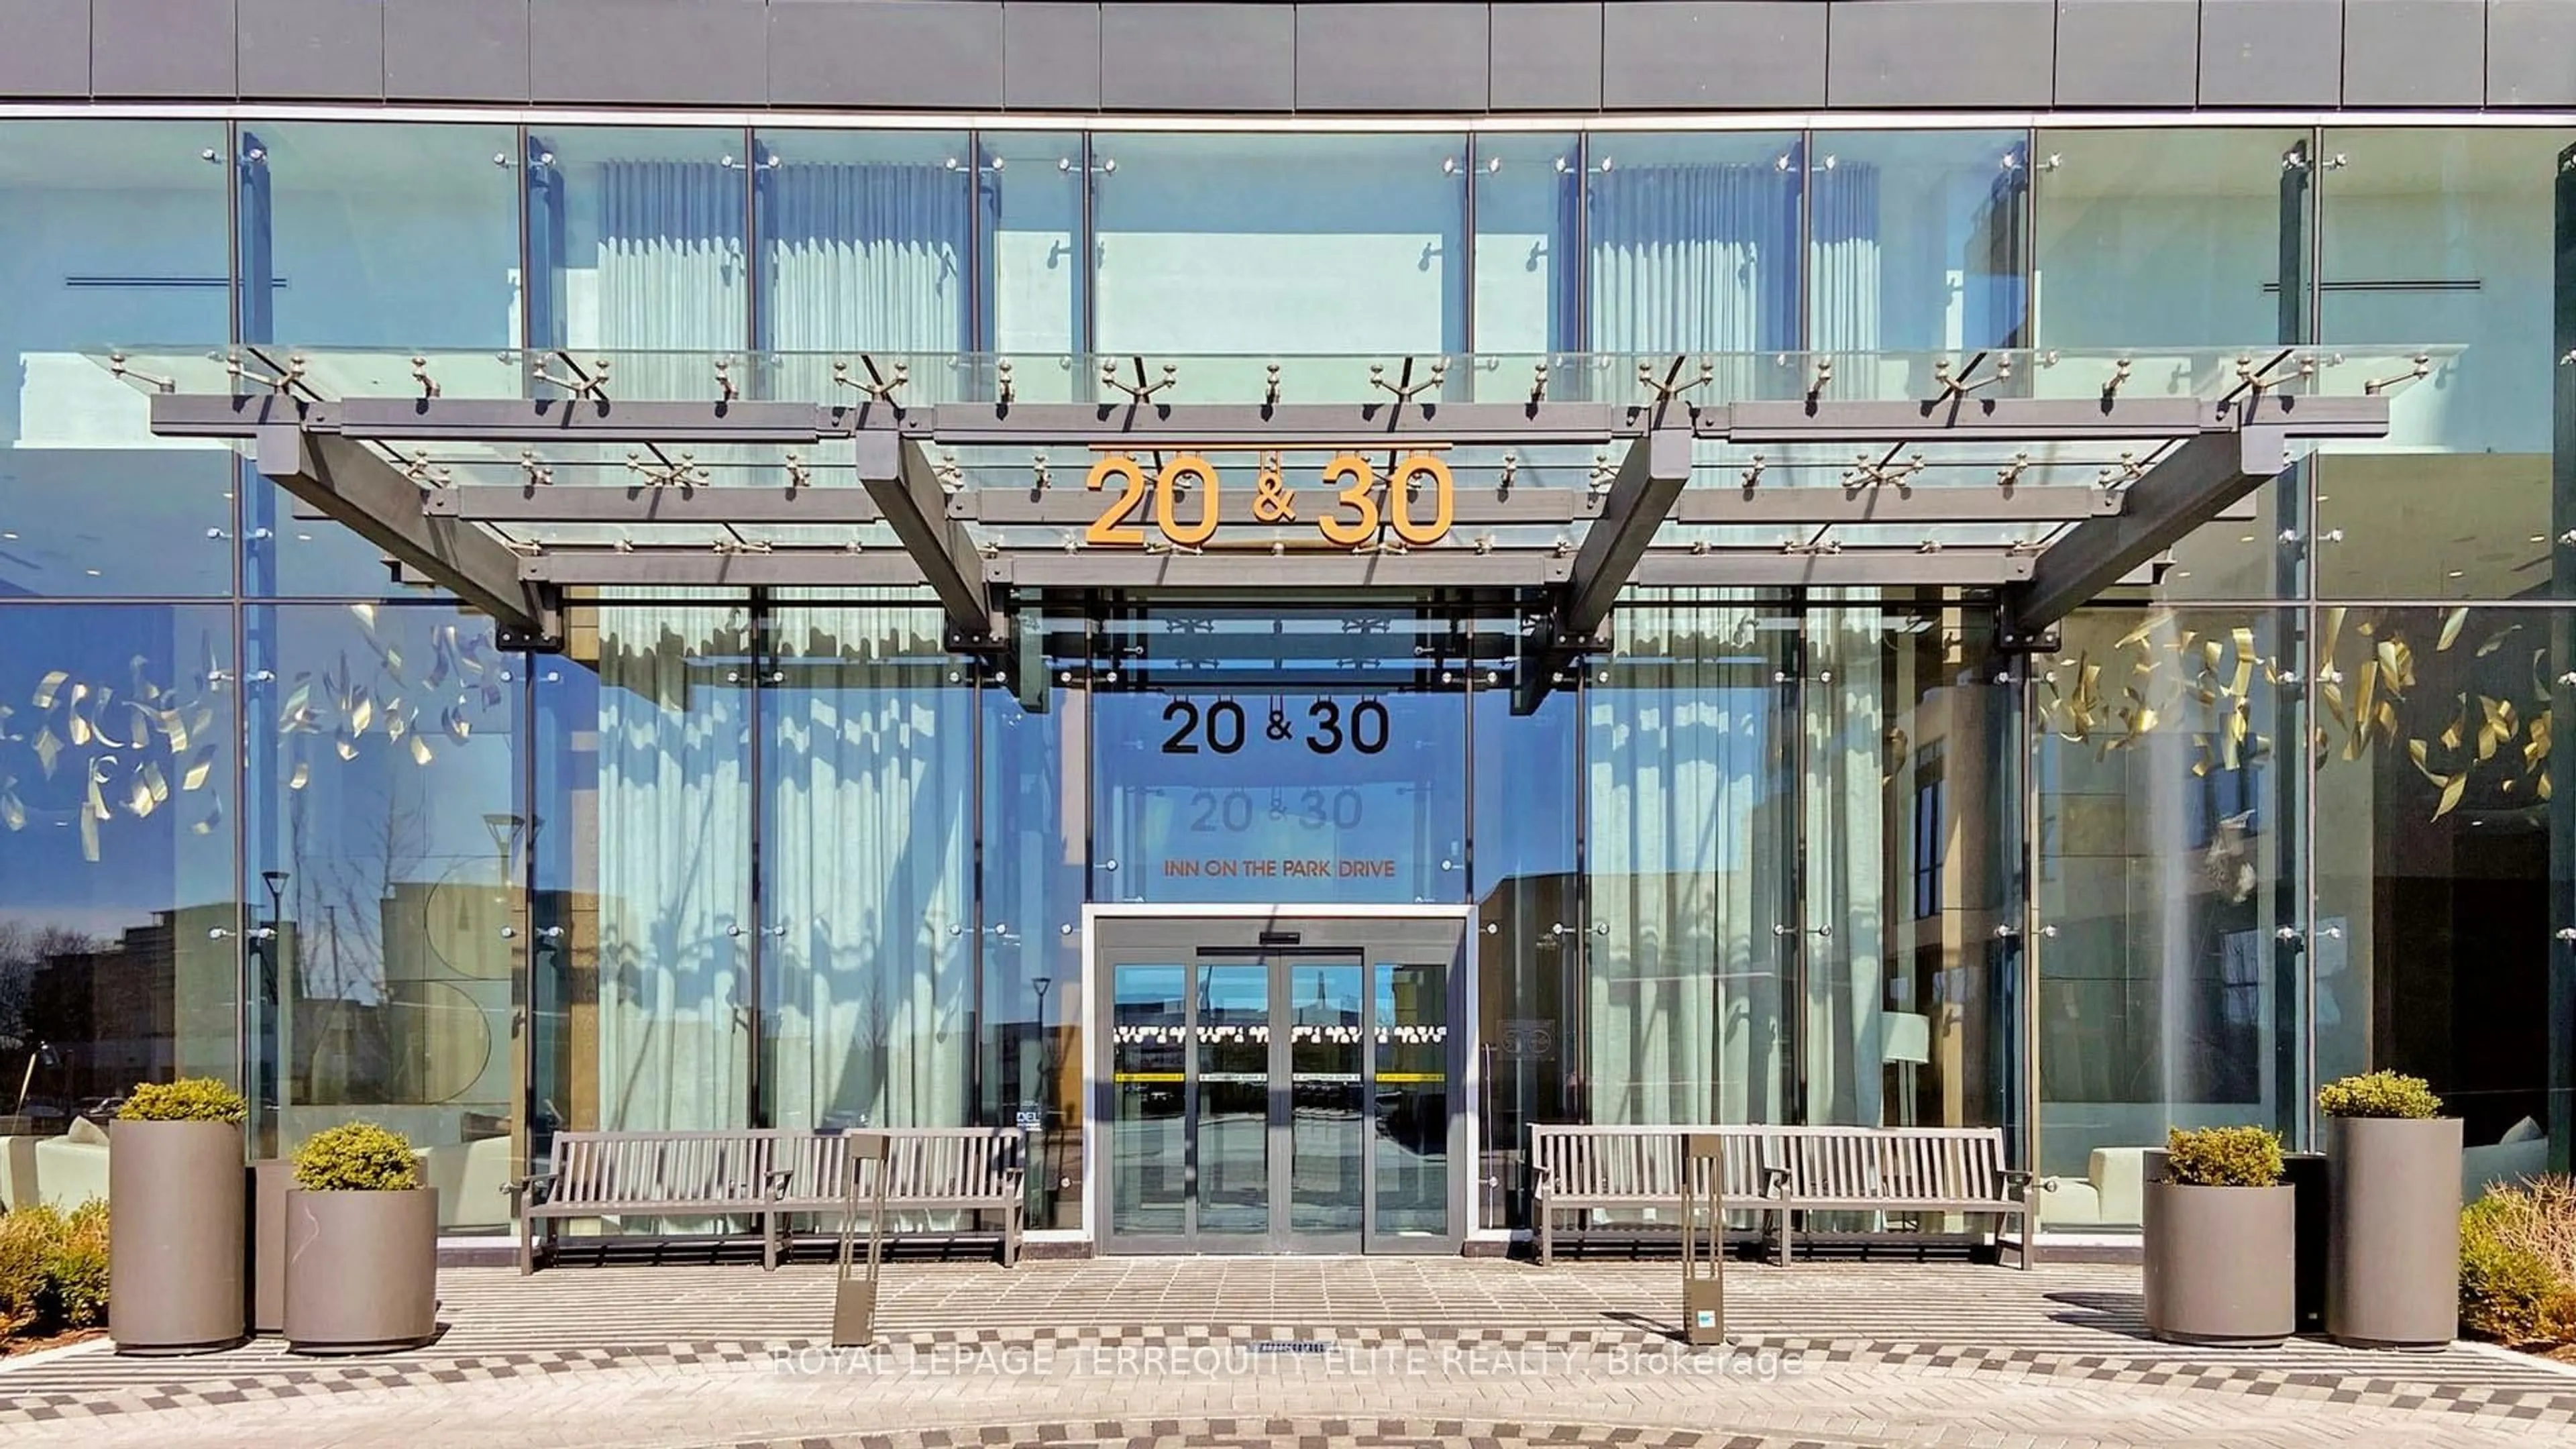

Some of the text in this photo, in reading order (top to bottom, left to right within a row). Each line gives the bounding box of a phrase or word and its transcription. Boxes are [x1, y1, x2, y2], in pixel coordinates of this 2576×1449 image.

[1085, 455, 1454, 545] 20 & 30
[1162, 700, 1389, 755] 20 & 30
[1191, 792, 1252, 832] 20
[1299, 790, 1362, 830] 30
[1164, 859, 1395, 877] INN ON THE PARK DRIVE
